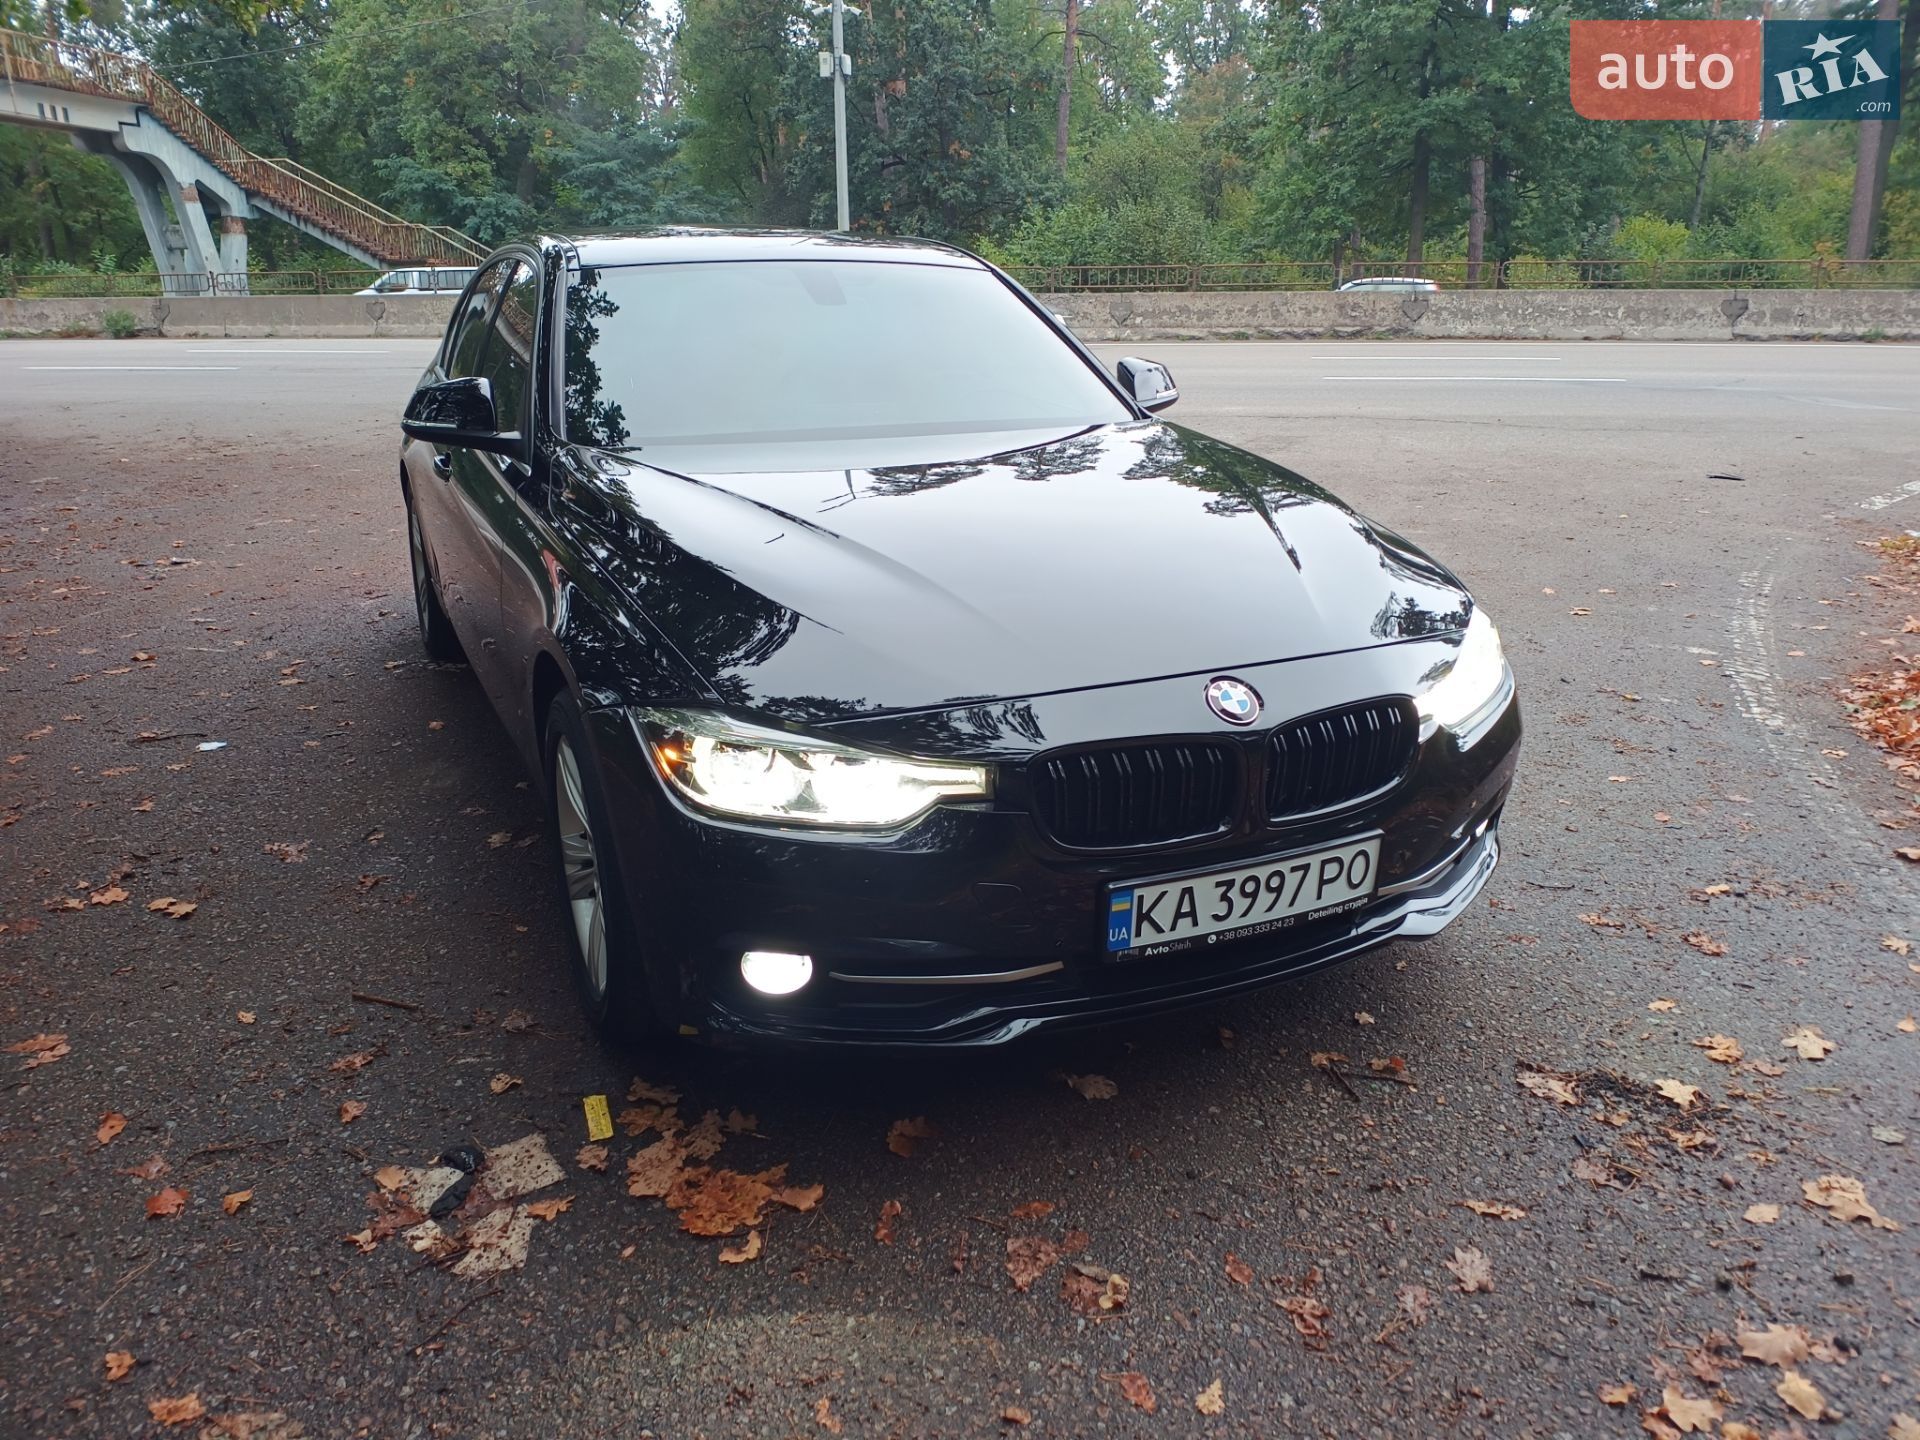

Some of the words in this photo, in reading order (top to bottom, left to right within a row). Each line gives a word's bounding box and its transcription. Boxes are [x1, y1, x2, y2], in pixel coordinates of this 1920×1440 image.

[1133, 885, 1199, 939] KA
[1210, 862, 1312, 923] 3997
[1316, 848, 1371, 901] PO
[1109, 926, 1129, 942] UA
[1236, 926, 1253, 938] 093
[1254, 922, 1270, 934] 333
[1271, 920, 1282, 930] 24
[1283, 917, 1295, 927] 23
